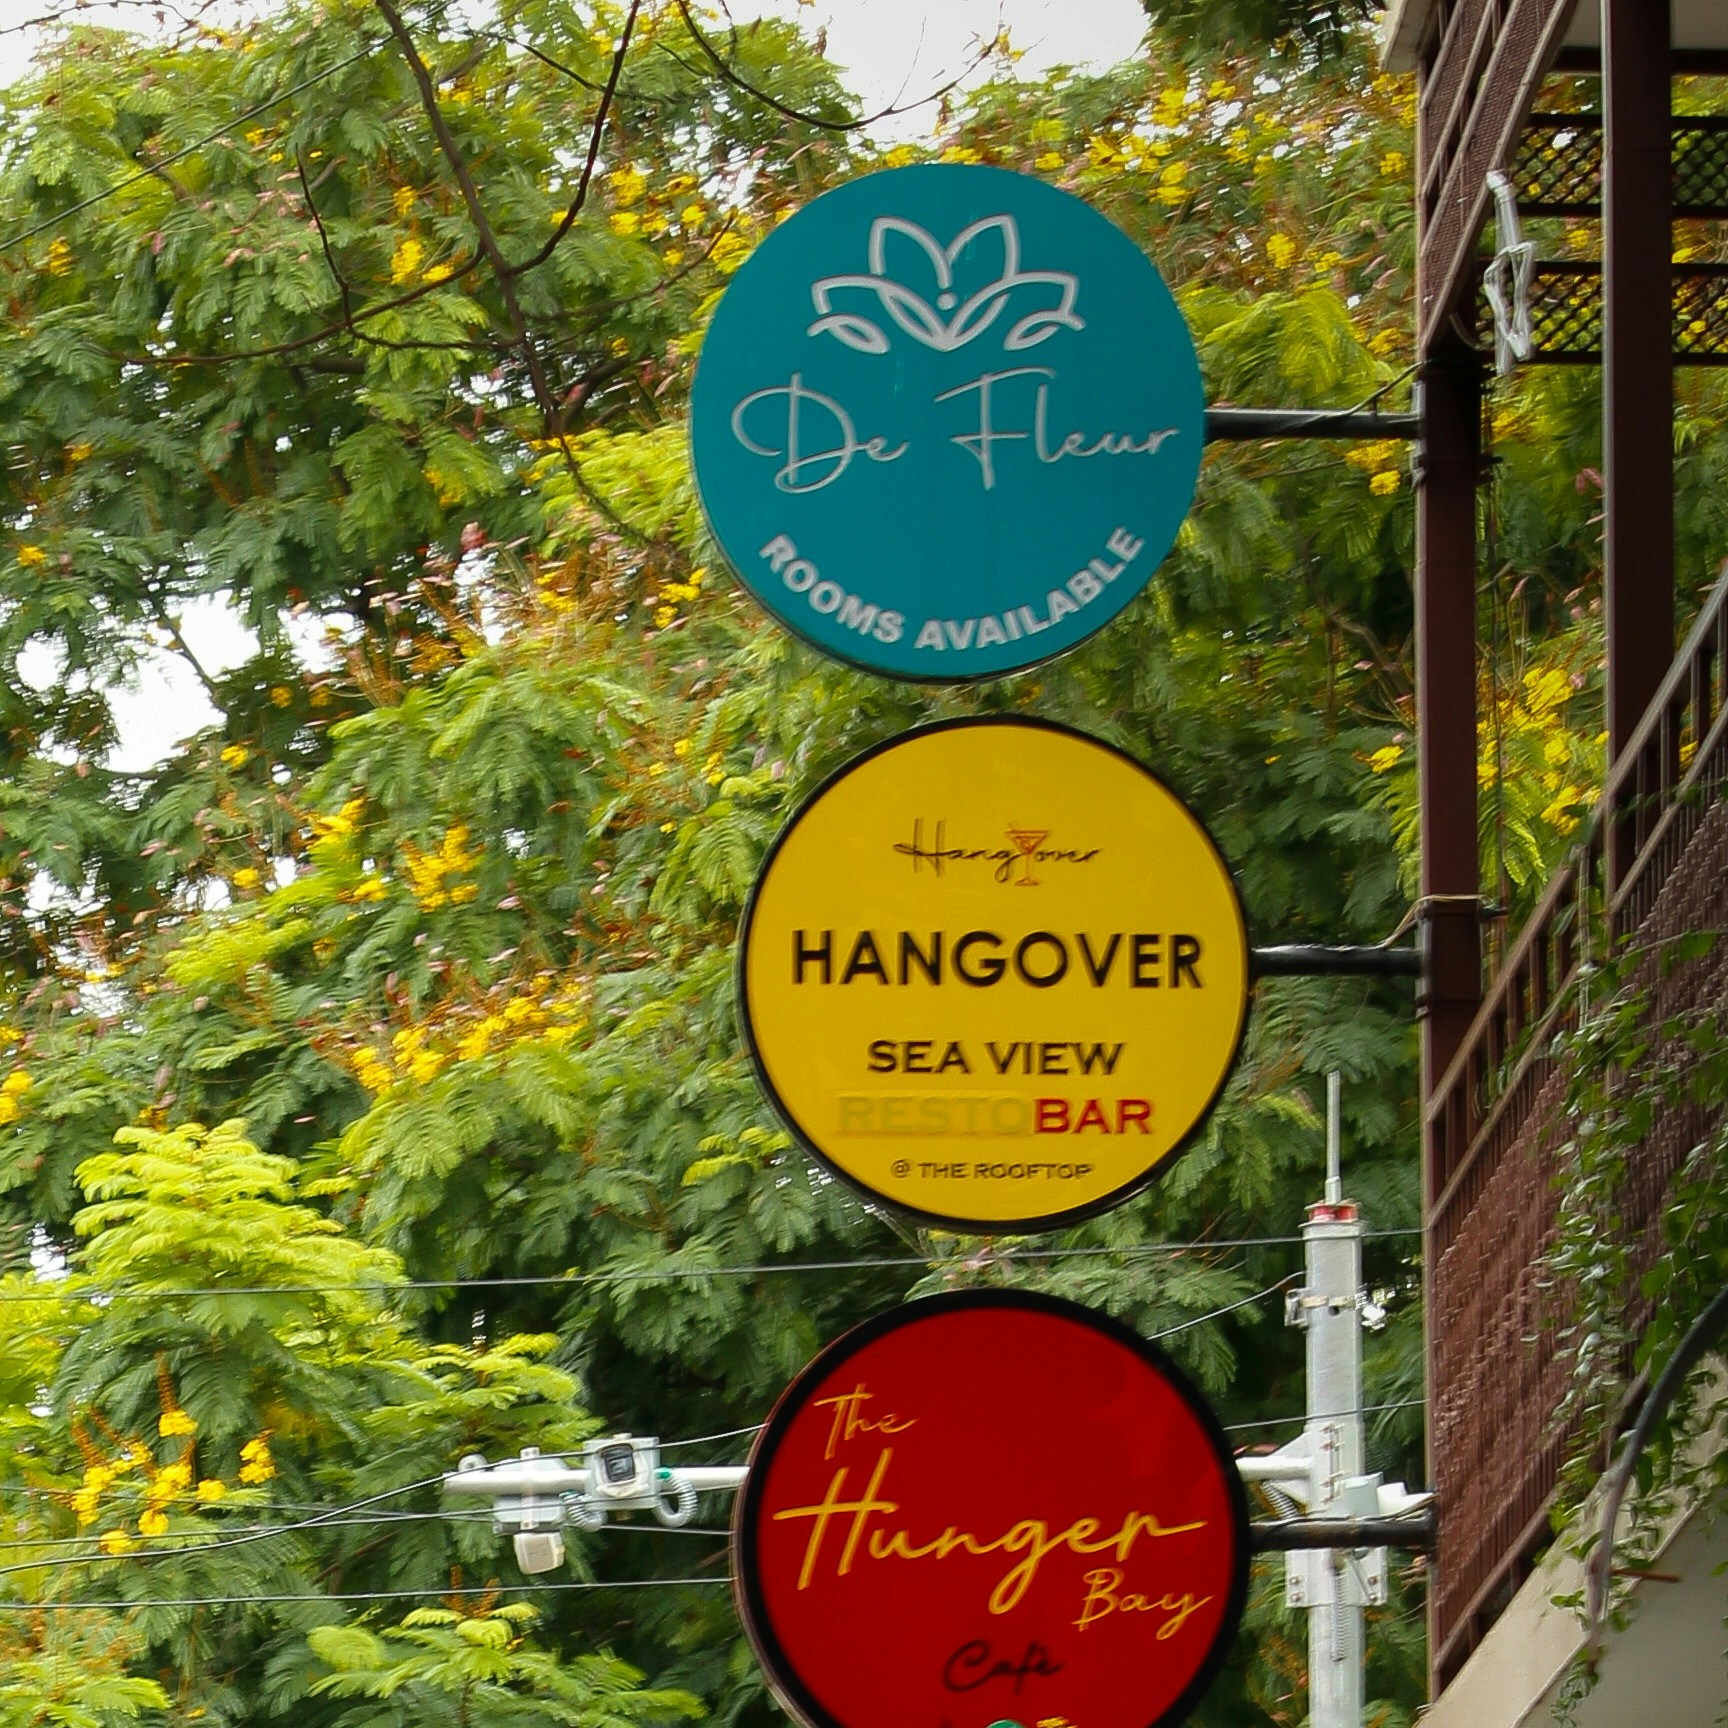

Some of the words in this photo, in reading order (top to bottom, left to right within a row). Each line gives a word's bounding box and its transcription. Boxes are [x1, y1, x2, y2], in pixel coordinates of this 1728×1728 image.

[731, 372, 911, 494] De
[934, 366, 1181, 491] Fleur
[760, 532, 906, 644] ROOMS
[914, 525, 1145, 652] AVAILABLE
[791, 929, 1204, 990] HANGOVER
[866, 1039, 974, 1076] SEA
[984, 1040, 1125, 1077] VIEW
[1034, 1097, 1153, 1135] BAR
[891, 1159, 913, 1179] @
[917, 1162, 968, 1180] THE
[971, 1162, 1095, 1181] ROOFTOP
[812, 1383, 919, 1460] The
[772, 1448, 1208, 1615] Hunger
[1071, 1567, 1216, 1641] Bay
